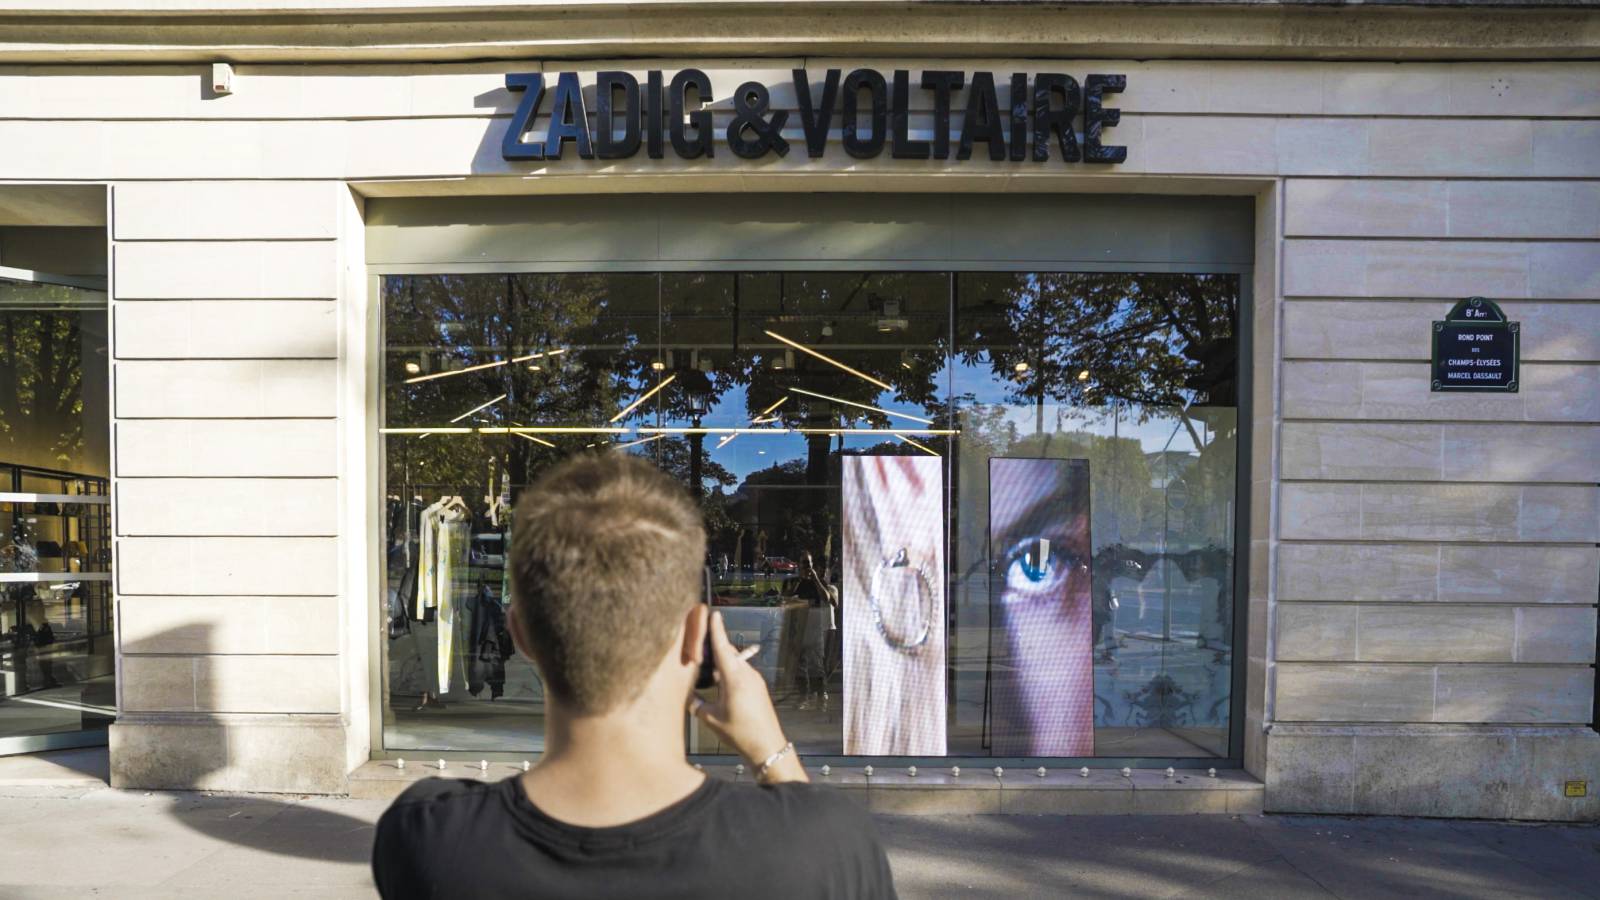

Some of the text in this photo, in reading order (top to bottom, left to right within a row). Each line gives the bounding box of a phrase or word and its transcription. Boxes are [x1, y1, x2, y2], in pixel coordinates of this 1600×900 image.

[502, 68, 1127, 164] ZADIG & VOLTAIRE
